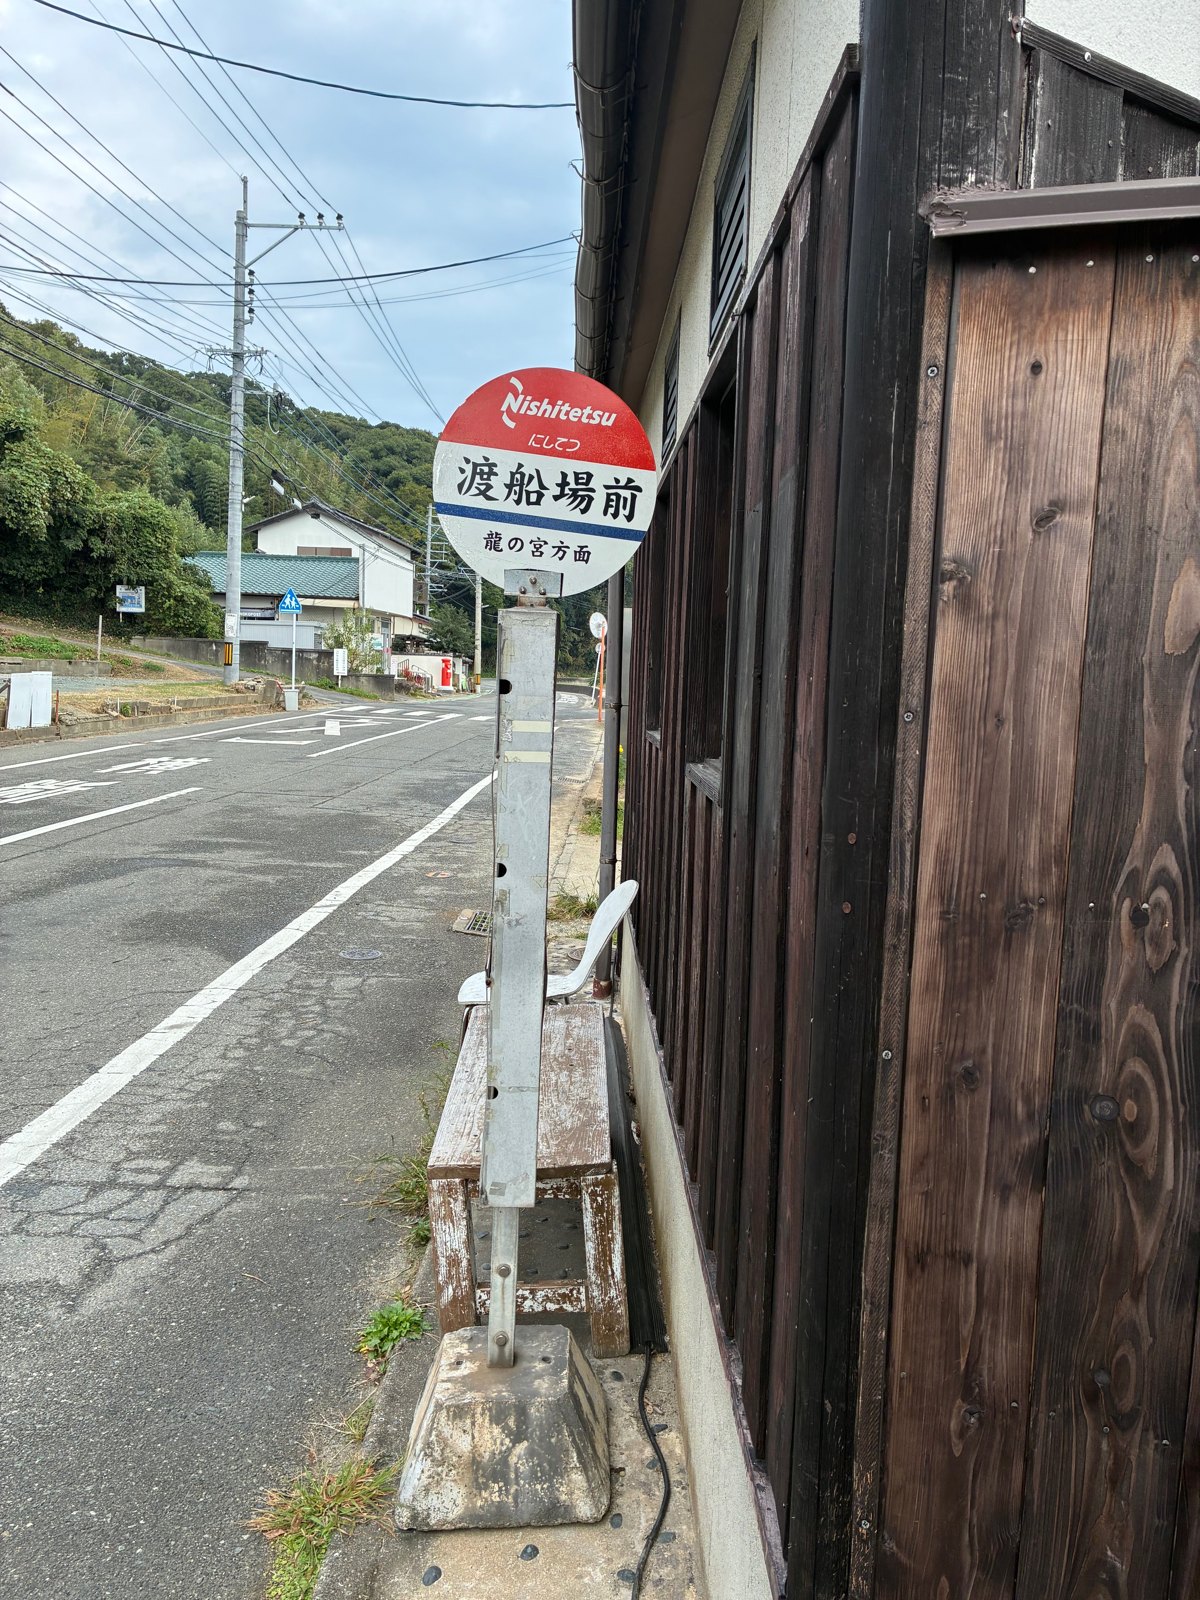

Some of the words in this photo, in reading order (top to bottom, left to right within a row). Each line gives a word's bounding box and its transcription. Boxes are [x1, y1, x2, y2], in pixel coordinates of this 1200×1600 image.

[501, 380, 617, 428] Nishitetsu
[528, 433, 581, 452] にしてつ
[457, 455, 643, 523] 渡船場前
[483, 530, 592, 564] 龍の宮方面
